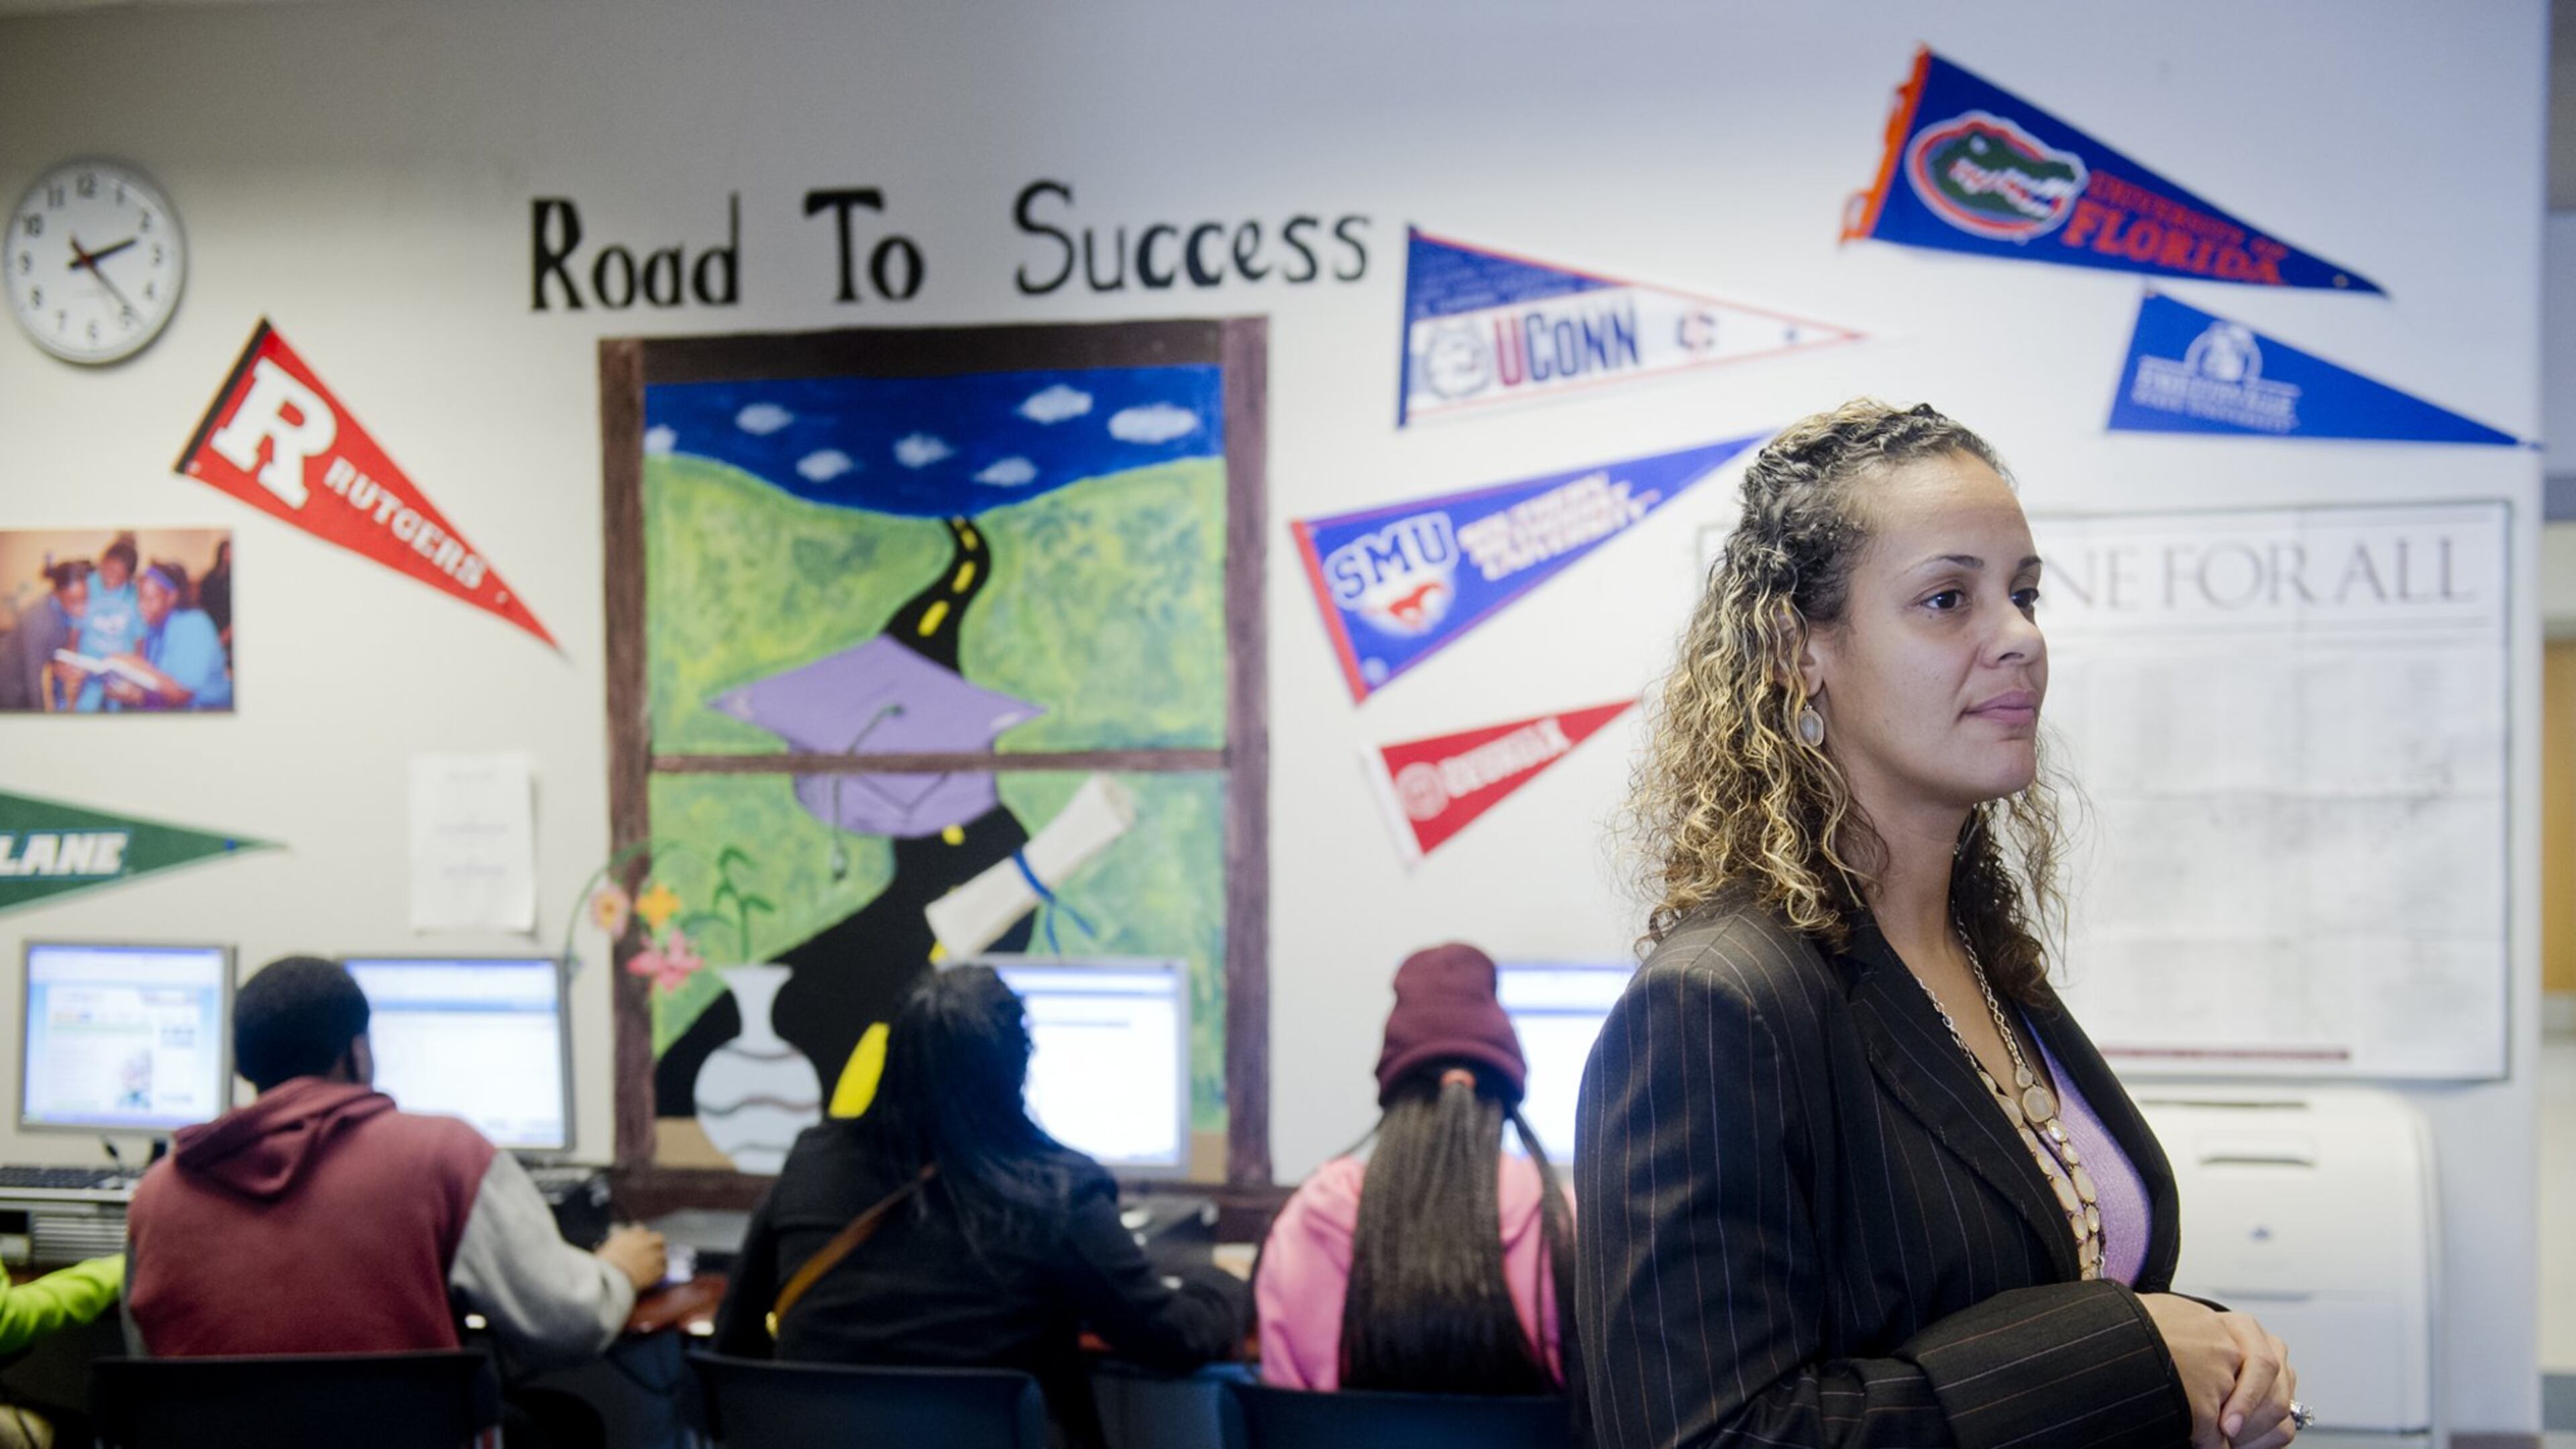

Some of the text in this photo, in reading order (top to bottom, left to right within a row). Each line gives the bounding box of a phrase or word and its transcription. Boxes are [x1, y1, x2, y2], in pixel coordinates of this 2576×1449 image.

[23, 213, 44, 237] 10
[47, 185, 65, 209] 11
[76, 172, 97, 199] 12
[530, 191, 741, 313] Road
[804, 186, 927, 305] To
[1012, 180, 1373, 298] Success
[2061, 199, 2286, 287] FLORIDA
[211, 357, 337, 510] R
[325, 456, 487, 590] RUTGERS
[1332, 521, 1449, 600] SMU
[2161, 539, 2324, 610] FOR
[2337, 537, 2477, 604] ALL
